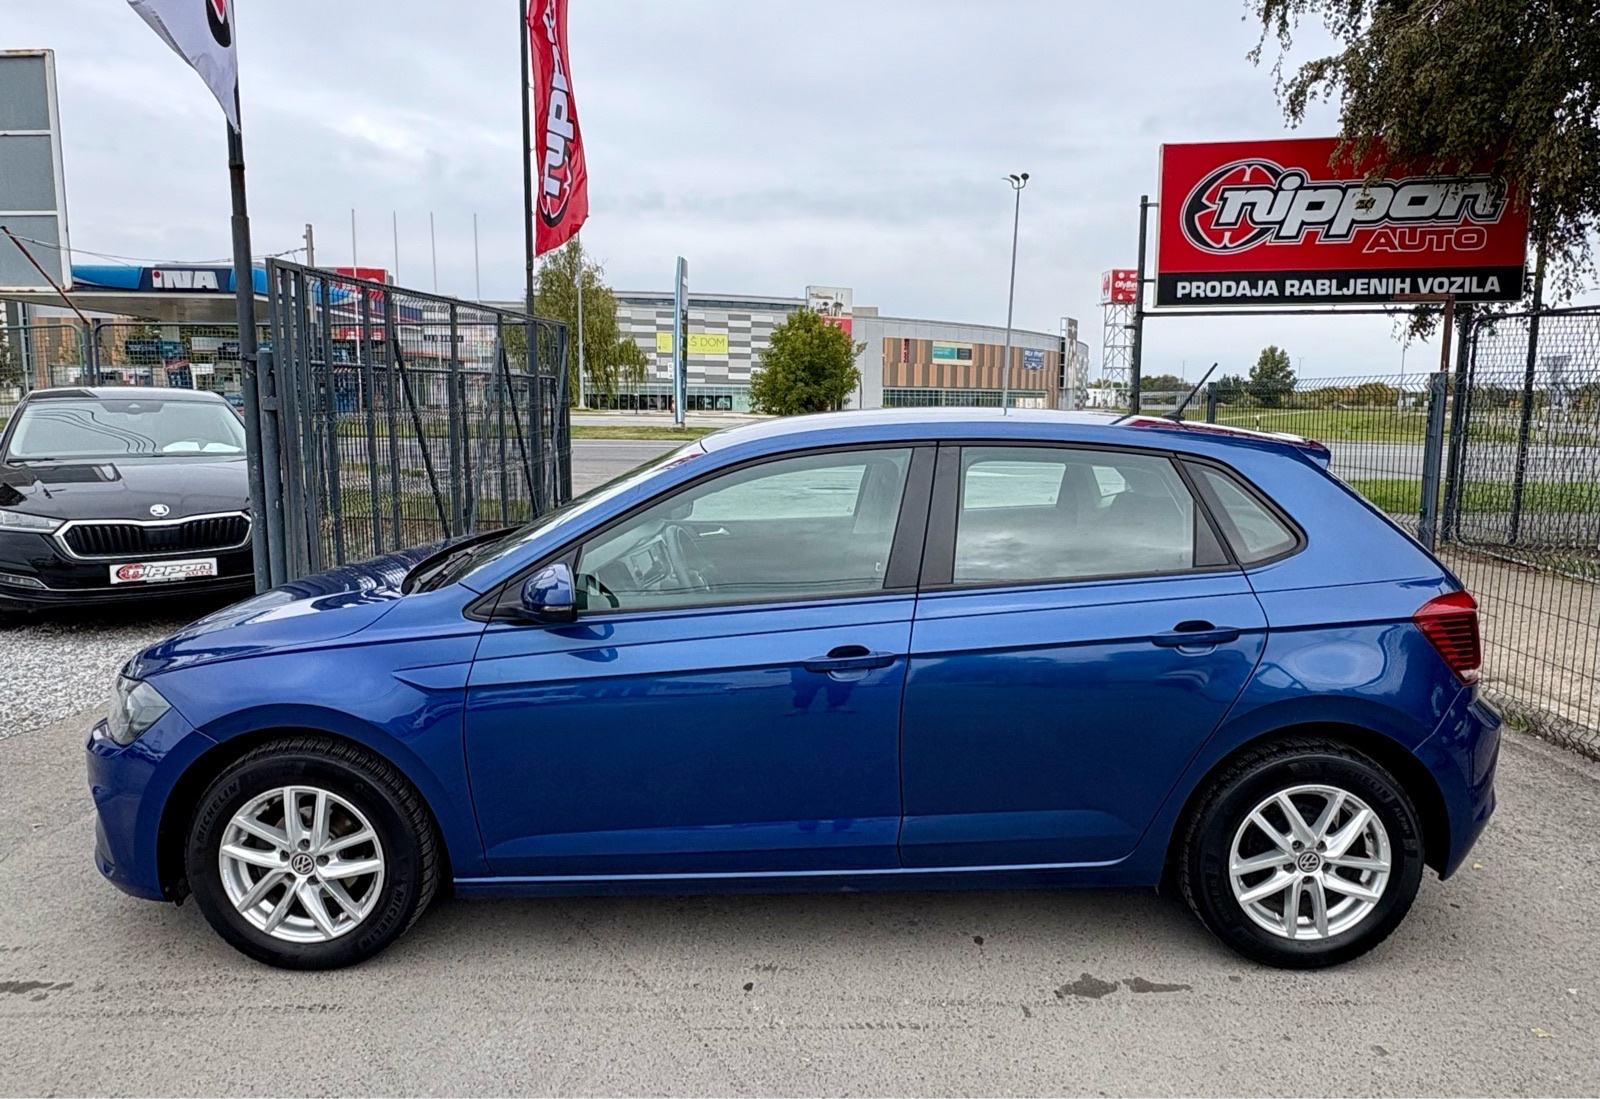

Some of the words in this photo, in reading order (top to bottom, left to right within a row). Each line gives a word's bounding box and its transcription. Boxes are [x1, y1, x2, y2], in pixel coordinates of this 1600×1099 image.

[1213, 169, 1506, 244] nippon
[1362, 226, 1488, 253] AUTO
[151, 269, 220, 290] INA
[1176, 280, 1279, 298] PRODAJA
[1284, 278, 1411, 297] RABLJENIH
[1417, 276, 1501, 294] VOZILA
[700, 337, 725, 348] DOM
[128, 562, 213, 579] nippon
